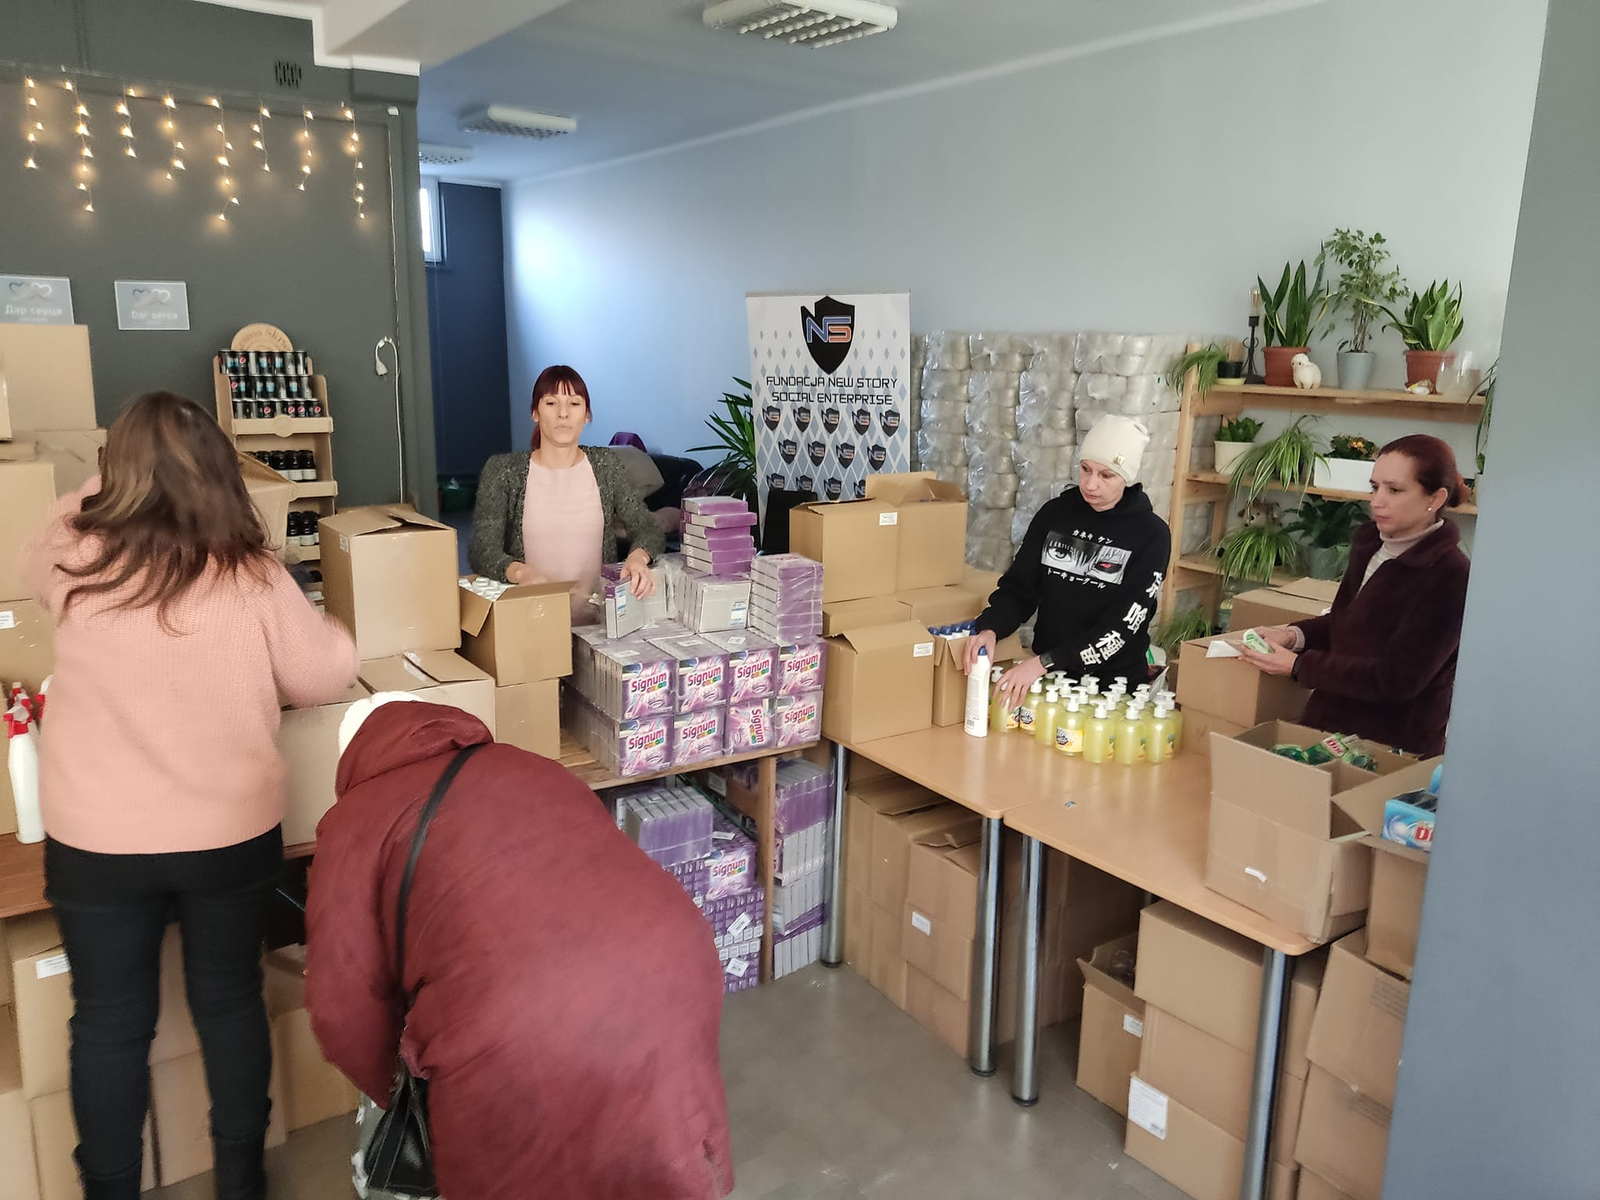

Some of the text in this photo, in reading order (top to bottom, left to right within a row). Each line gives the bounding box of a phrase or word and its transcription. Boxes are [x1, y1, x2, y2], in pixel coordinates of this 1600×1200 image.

[806, 316, 852, 343] NS
[766, 376, 898, 389] FUNDACJA NEW STORY
[772, 392, 892, 405] SOCIAL ENTERPRISE
[737, 660, 770, 678] Signum
[787, 654, 818, 672] Signum
[631, 672, 667, 692] Signum
[688, 666, 721, 686] Signum
[784, 704, 815, 724] Signum
[682, 720, 716, 739] Signum
[751, 708, 764, 743] Signum
[628, 728, 664, 750] Signum
[712, 858, 746, 877] Signum
